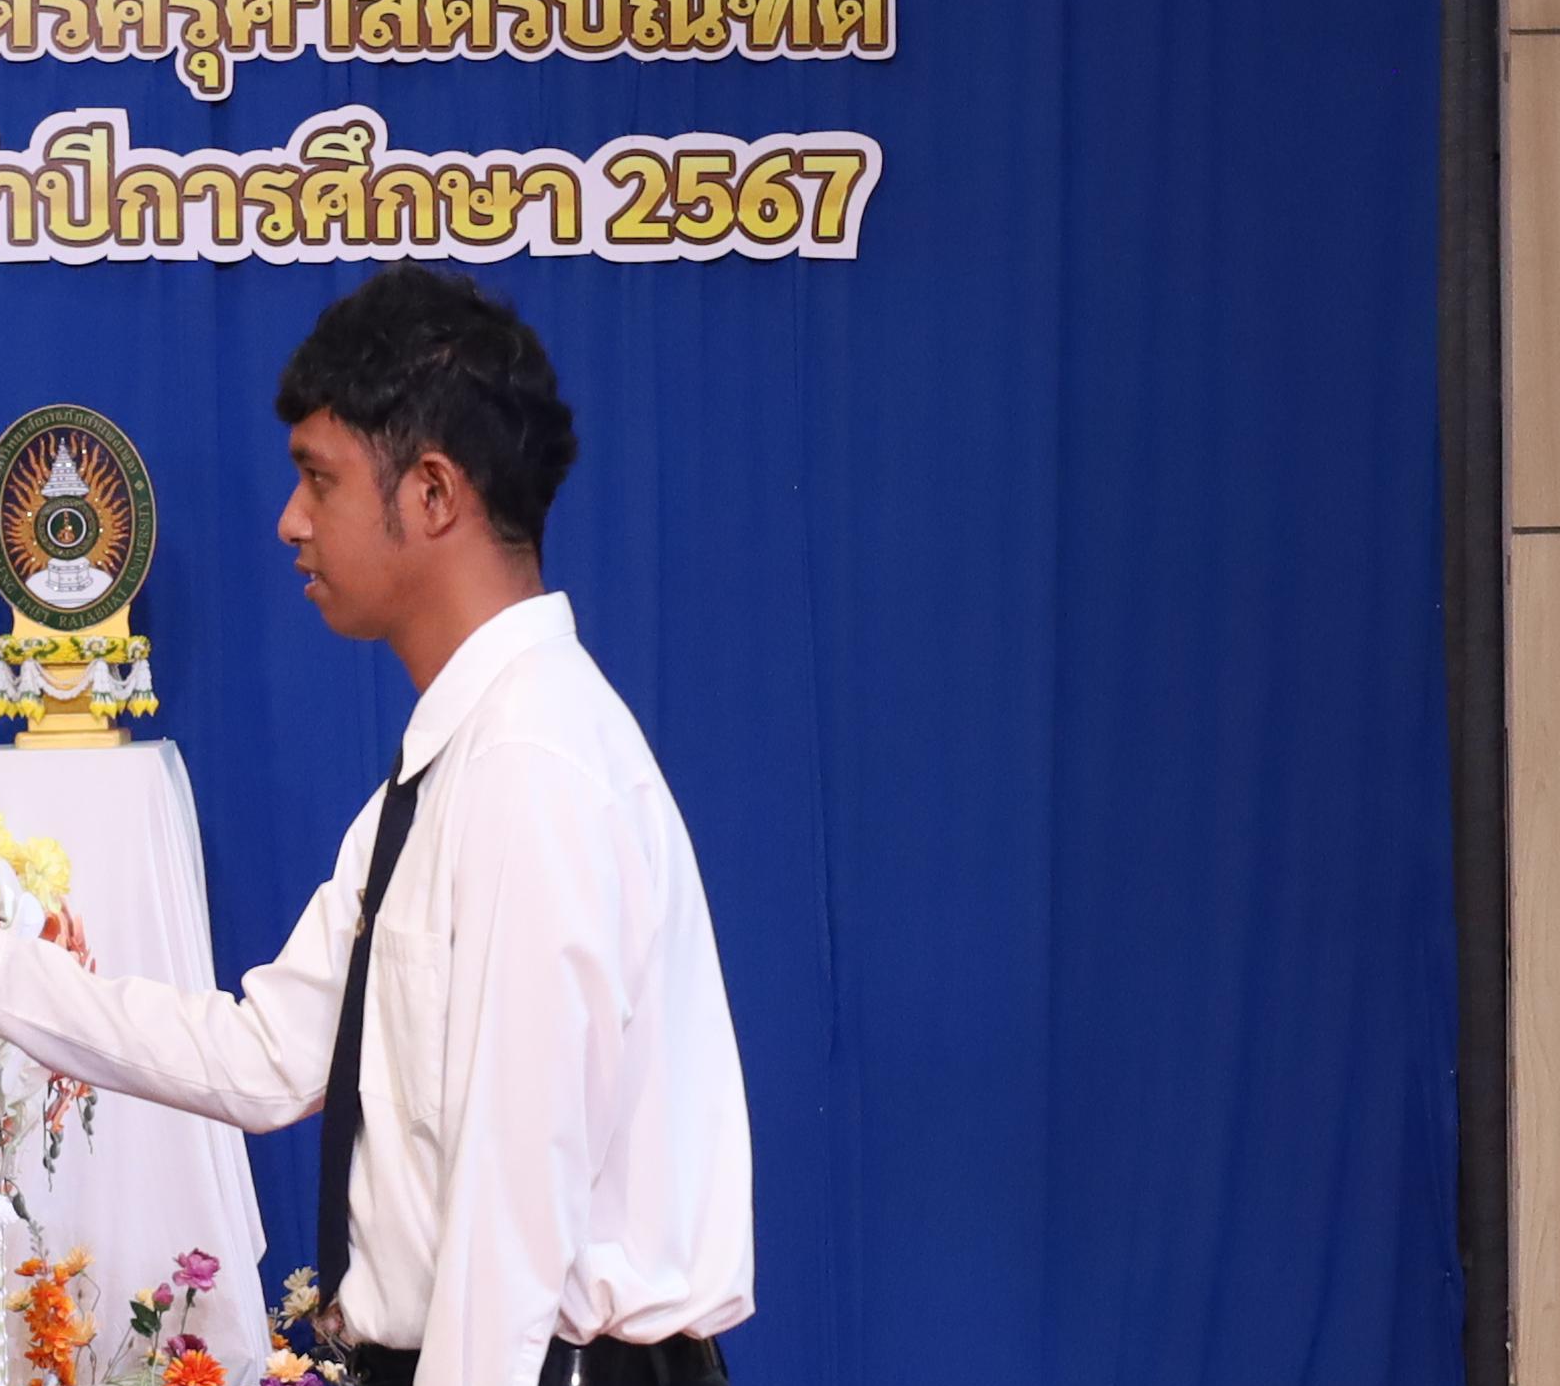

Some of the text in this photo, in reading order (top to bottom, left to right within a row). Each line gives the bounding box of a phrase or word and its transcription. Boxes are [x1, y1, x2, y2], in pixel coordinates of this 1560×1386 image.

[603, 149, 867, 245] 2567
[58, 590, 128, 628] RAJABHAT
[126, 501, 150, 583] UNIVERSITY
